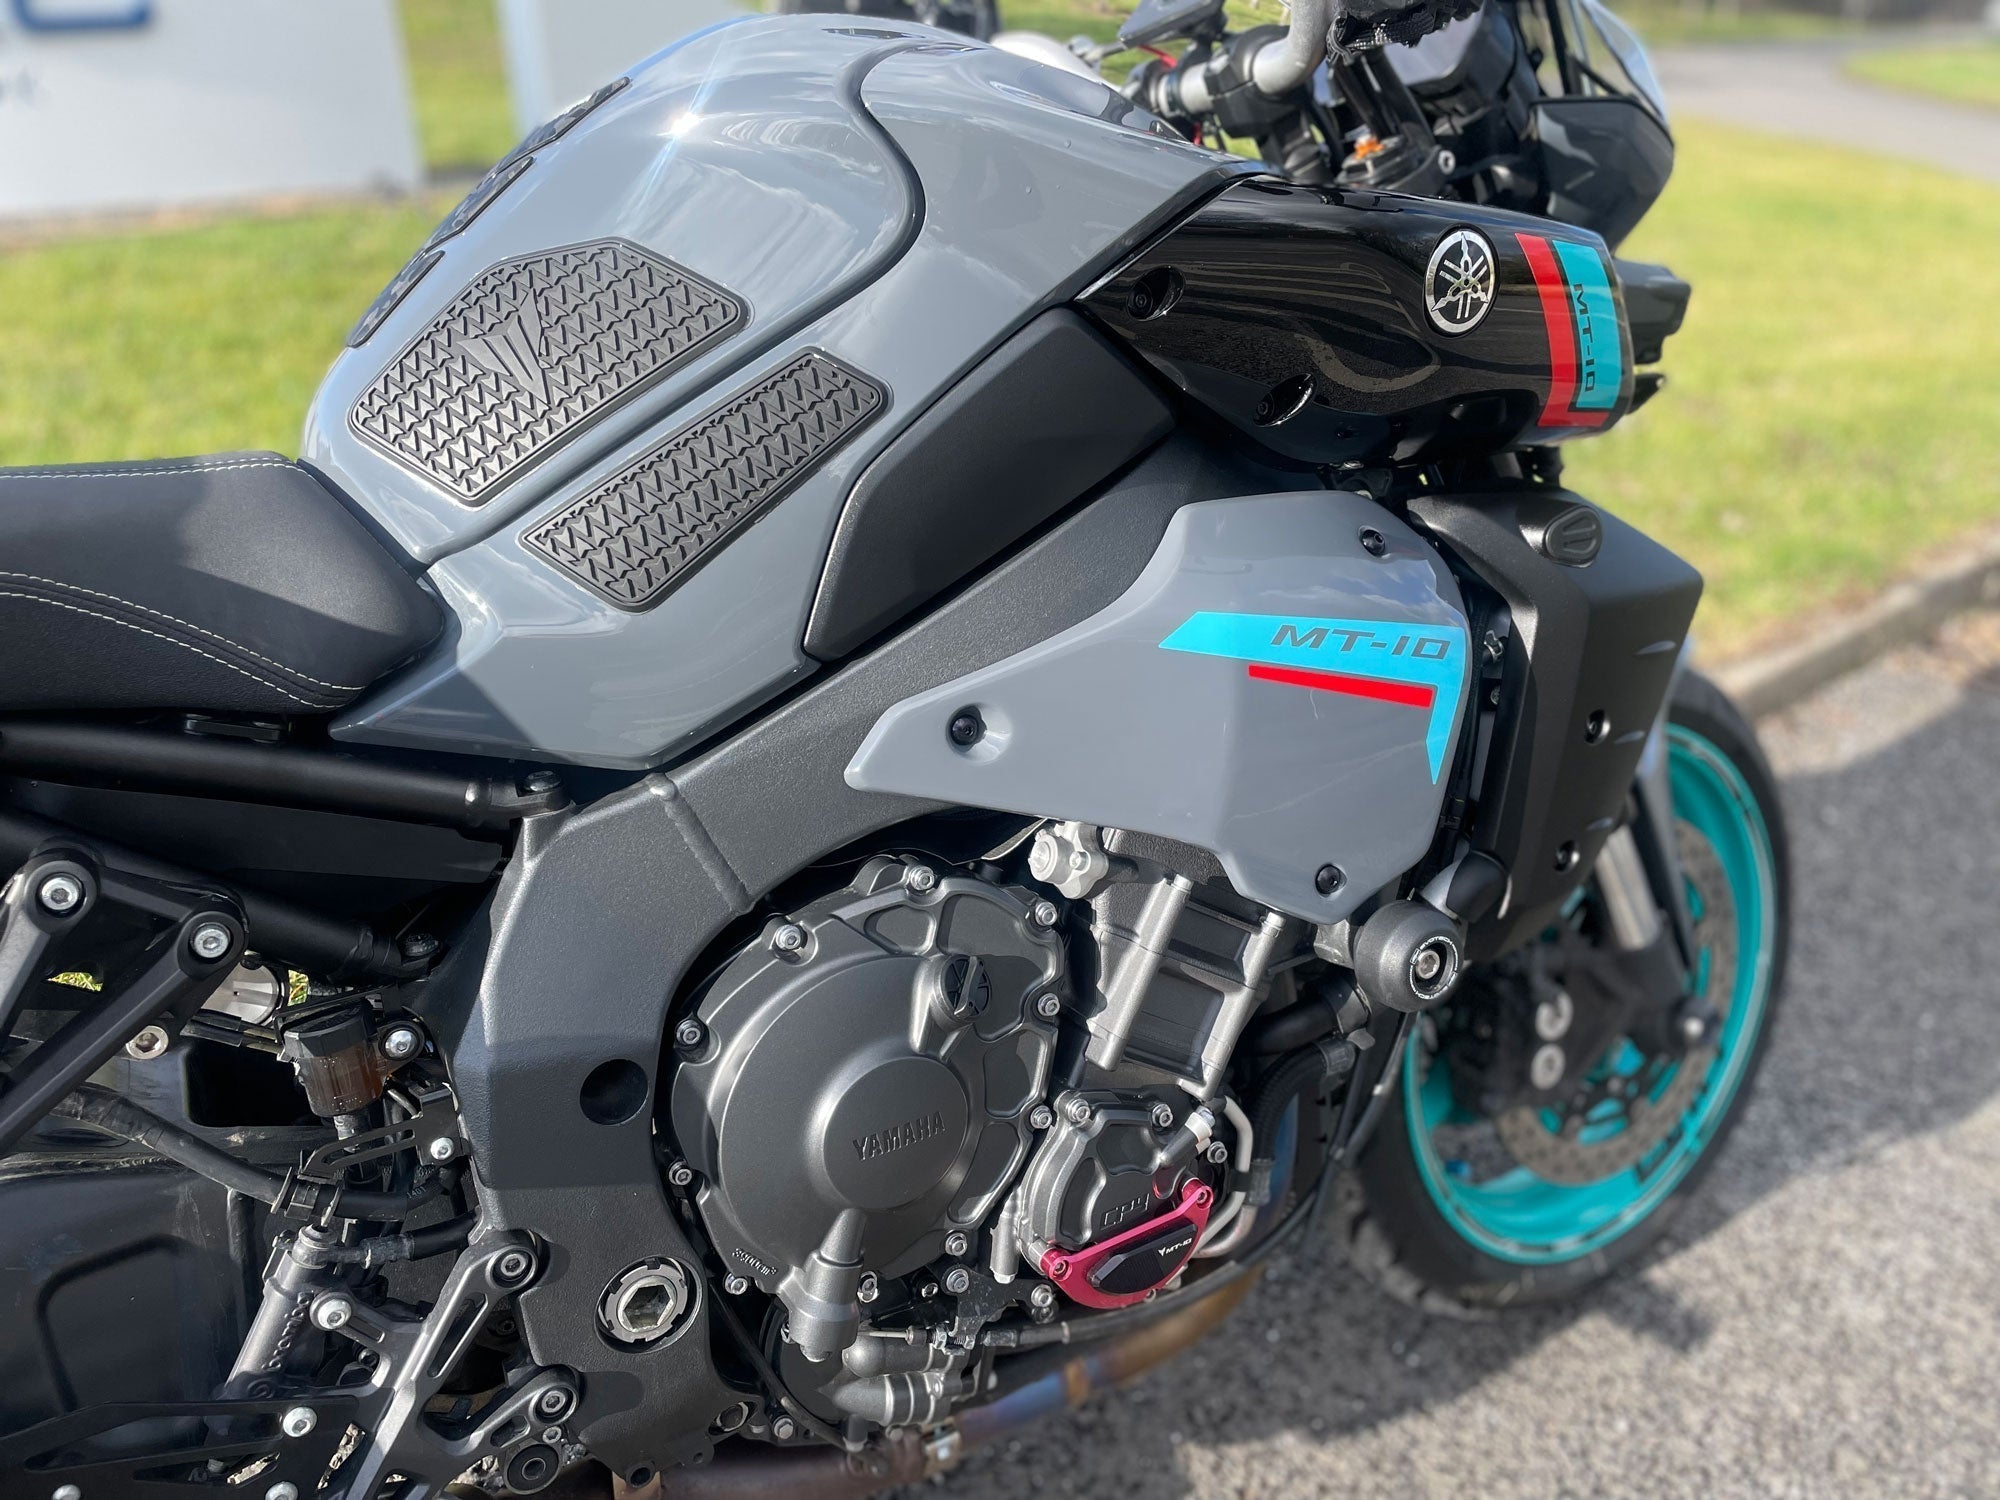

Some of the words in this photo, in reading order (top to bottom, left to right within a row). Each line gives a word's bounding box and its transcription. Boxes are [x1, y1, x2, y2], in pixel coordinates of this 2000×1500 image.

[1573, 283, 1596, 392] MT-10
[1270, 624, 1450, 660] MT-10
[852, 1110, 947, 1162] YAMAHA
[1165, 1237, 1193, 1255] MT-10
[261, 1291, 311, 1372] brembo
